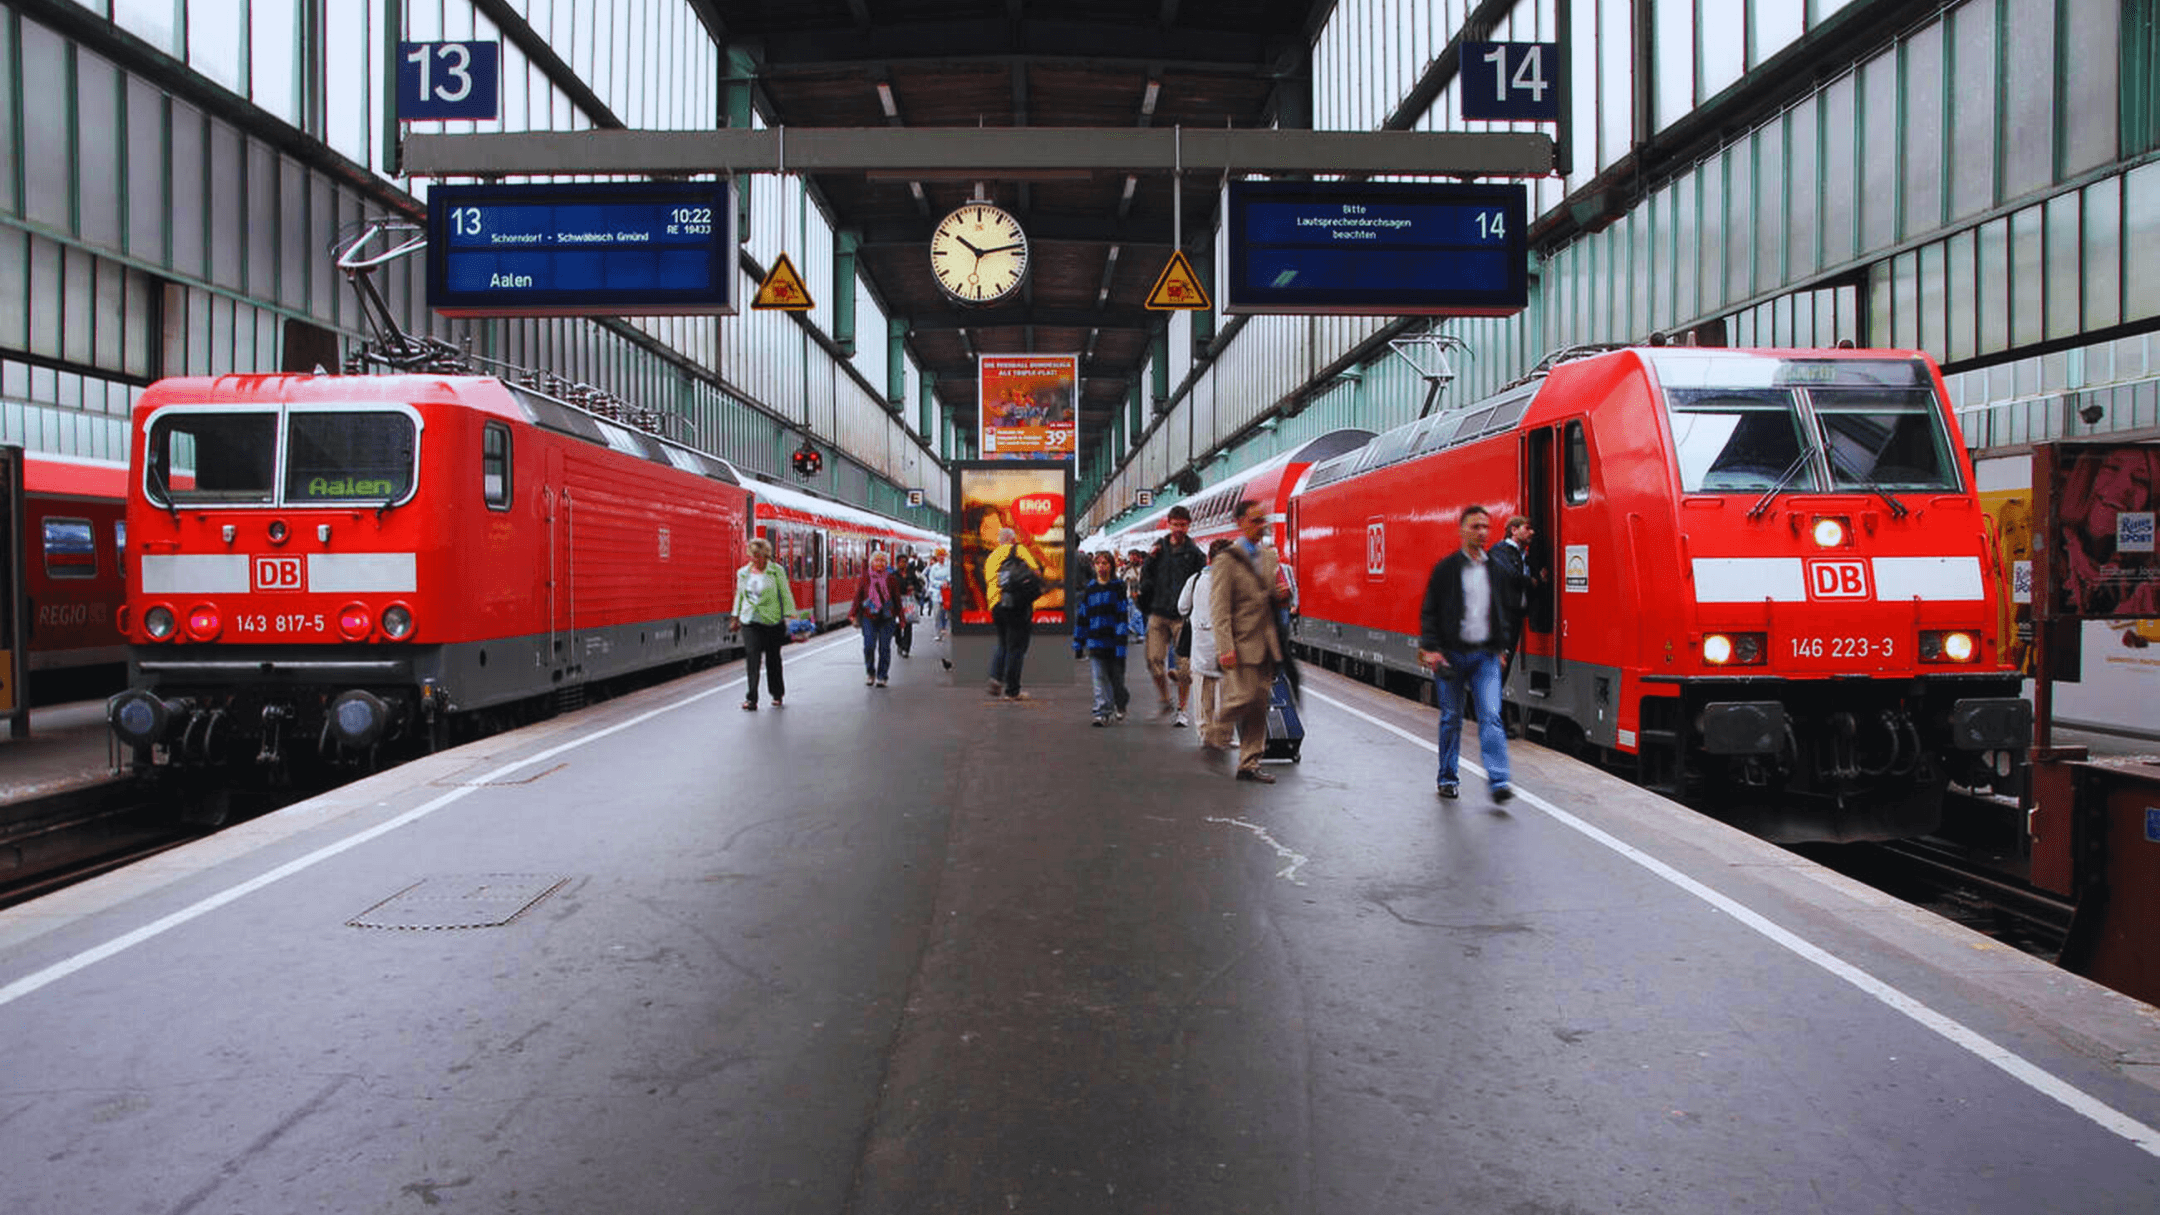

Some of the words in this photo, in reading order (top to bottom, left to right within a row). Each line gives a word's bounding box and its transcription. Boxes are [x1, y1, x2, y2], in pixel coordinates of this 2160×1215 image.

[408, 44, 472, 101] 13
[1484, 45, 1548, 101] 14
[671, 209, 711, 223] 10:22
[1343, 205, 1367, 214] Bitte
[452, 208, 482, 235] 13
[667, 225, 680, 235] RE
[1297, 217, 1412, 229] Lautsprecherdurchsagen
[1475, 212, 1505, 239] 14
[491, 233, 543, 243] Schorndorf
[557, 231, 614, 243] Schwäbisch
[617, 231, 649, 242] Gmünd
[1333, 229, 1377, 239] beachten
[490, 274, 533, 287] Aalen
[309, 478, 392, 496] Aalen
[1139, 492, 1149, 505] E
[259, 561, 298, 586] DB
[1815, 565, 1863, 594] DB
[39, 604, 86, 625] REGIO
[236, 615, 267, 632] 143
[275, 615, 325, 632] 817-5
[1791, 638, 1823, 657] 146
[1831, 637, 1894, 657] 223-3
